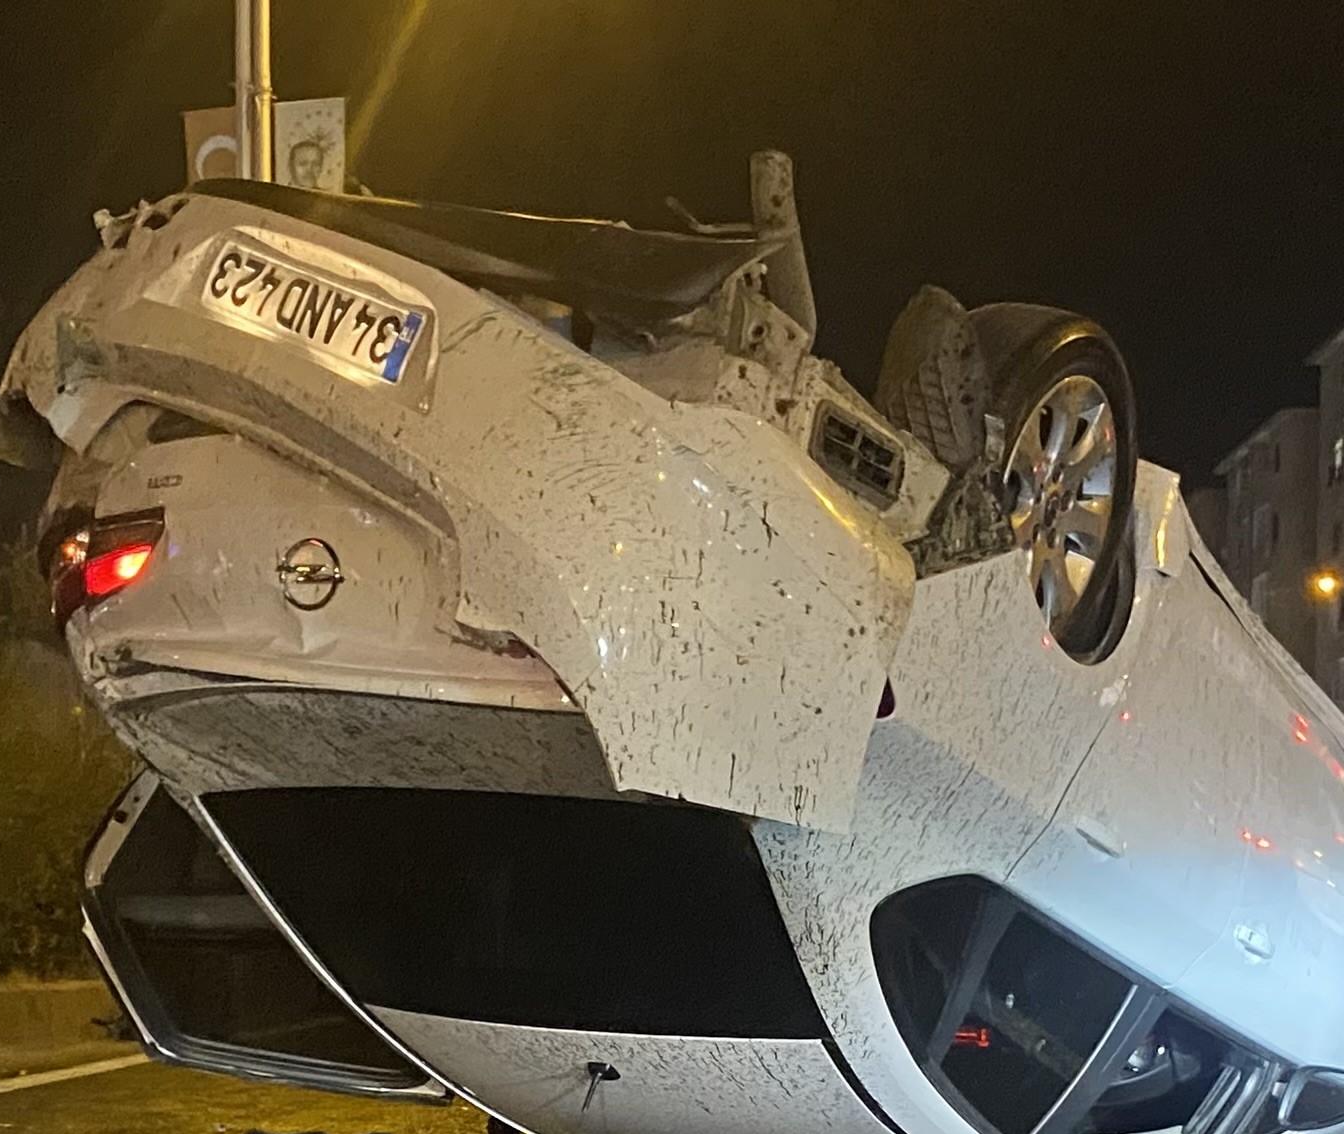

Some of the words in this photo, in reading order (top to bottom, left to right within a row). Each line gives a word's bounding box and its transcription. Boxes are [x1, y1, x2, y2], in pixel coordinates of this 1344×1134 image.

[210, 252, 282, 316] 423
[277, 278, 355, 344] AND
[352, 304, 401, 363] 34
